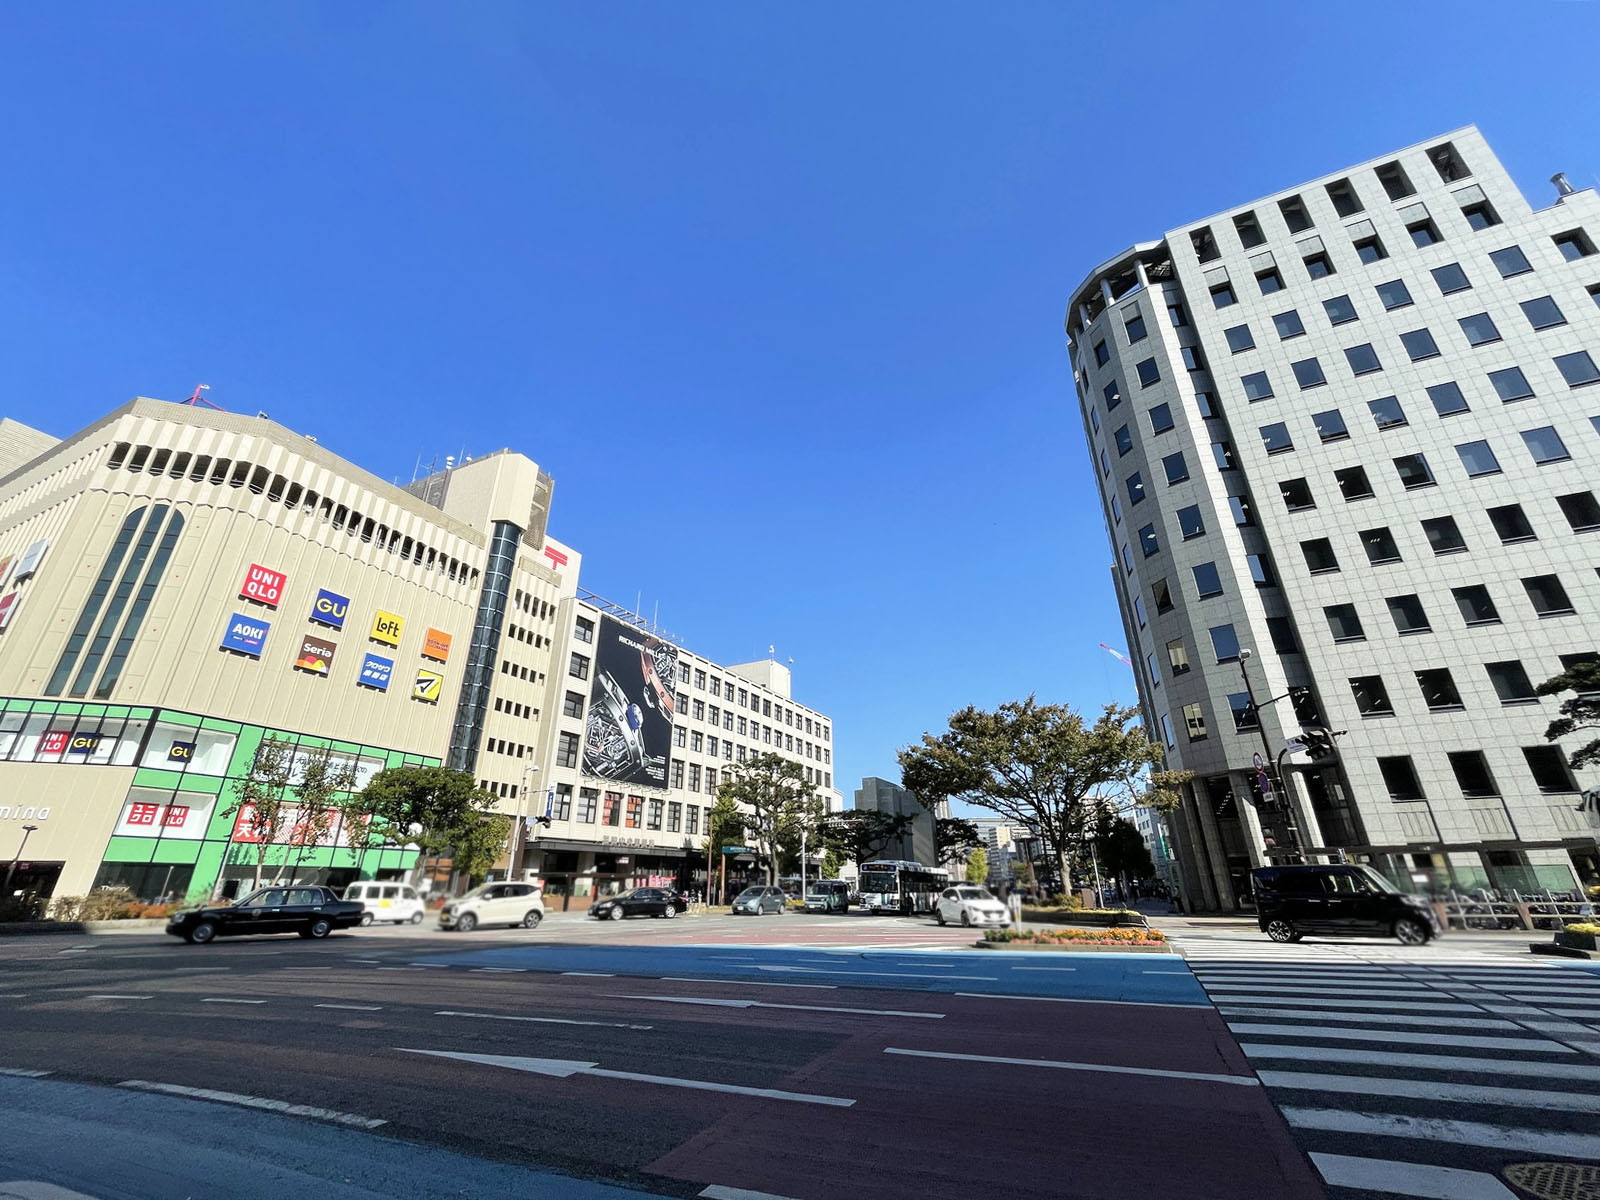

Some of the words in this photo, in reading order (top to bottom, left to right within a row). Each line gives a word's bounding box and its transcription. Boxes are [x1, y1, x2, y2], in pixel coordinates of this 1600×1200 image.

[251, 568, 280, 587] UNI
[247, 581, 278, 600] QLO
[316, 598, 347, 618] GU
[232, 623, 264, 640] AOKI
[303, 642, 332, 658] Seria
[618, 635, 645, 652] RICHARD
[73, 737, 97, 748] GU
[134, 804, 156, 814] ユニ
[130, 814, 153, 823] クロ
